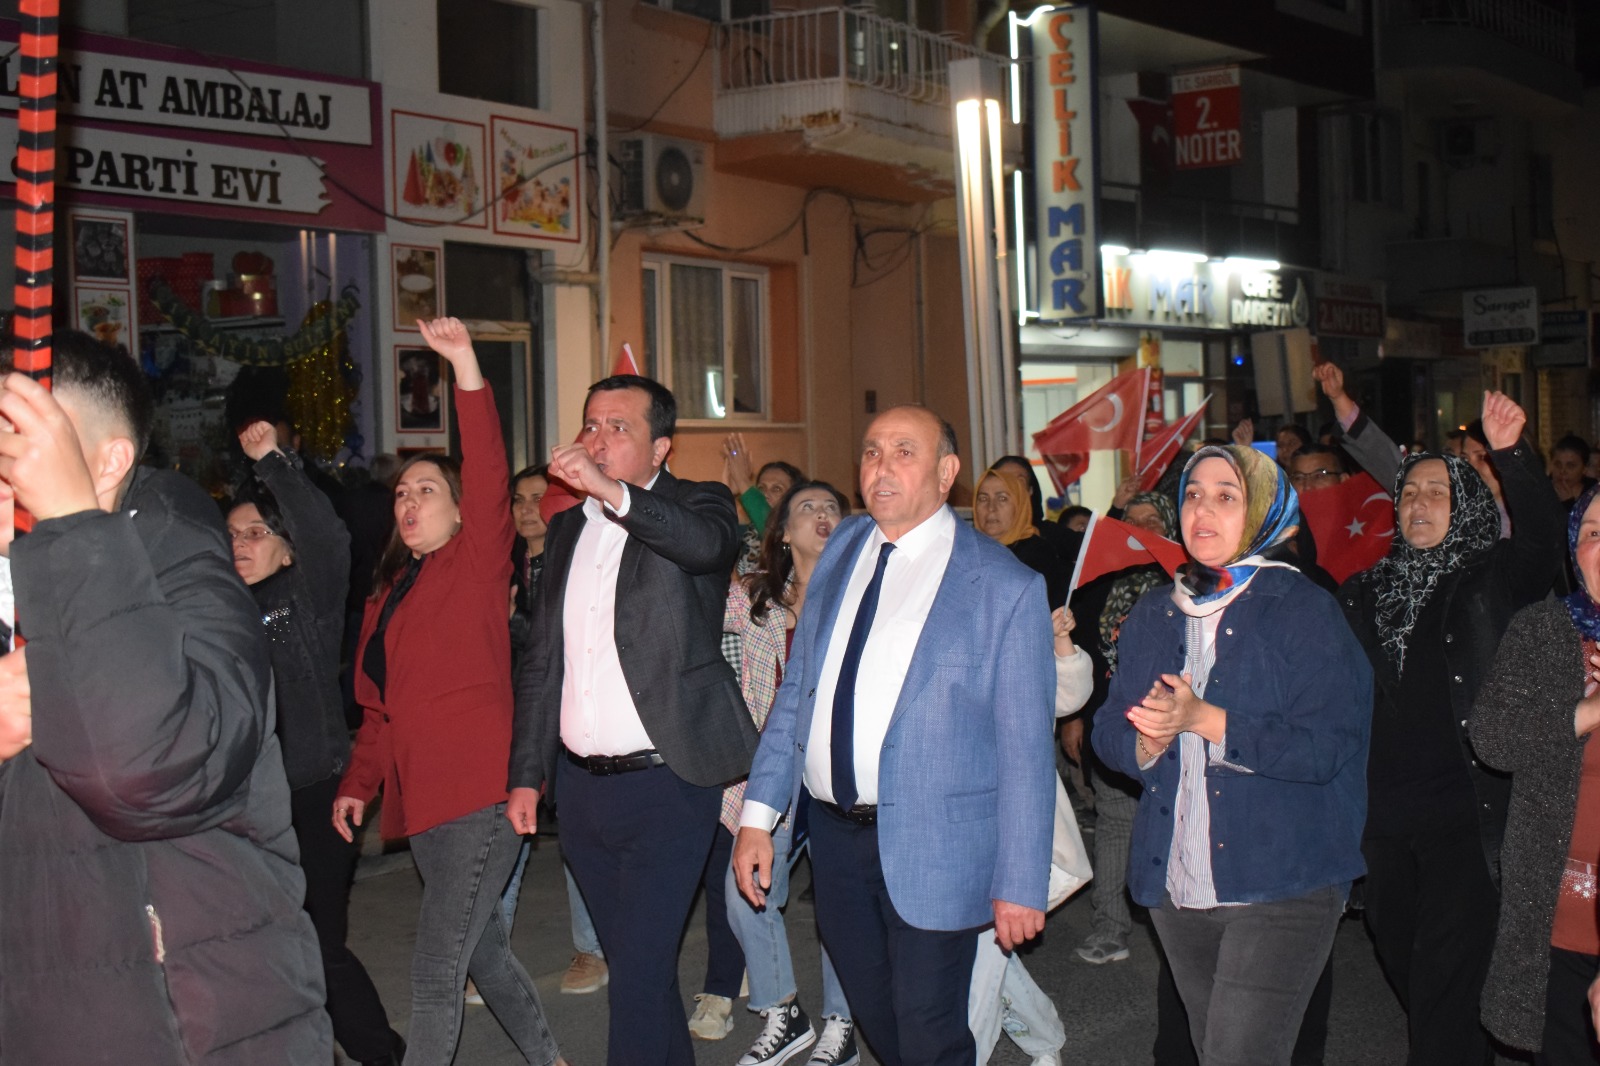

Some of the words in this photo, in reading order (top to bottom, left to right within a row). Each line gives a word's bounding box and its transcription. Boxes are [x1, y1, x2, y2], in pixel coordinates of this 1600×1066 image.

[95, 68, 148, 110] AT
[159, 76, 332, 131] AMBALAJ
[1047, 12, 1081, 193] ÇELİK
[1195, 96, 1219, 130] 2.
[64, 148, 199, 196] PARTİ
[211, 159, 282, 205] EVİ
[1175, 128, 1242, 166] NOTER
[1047, 203, 1087, 314] MAR
